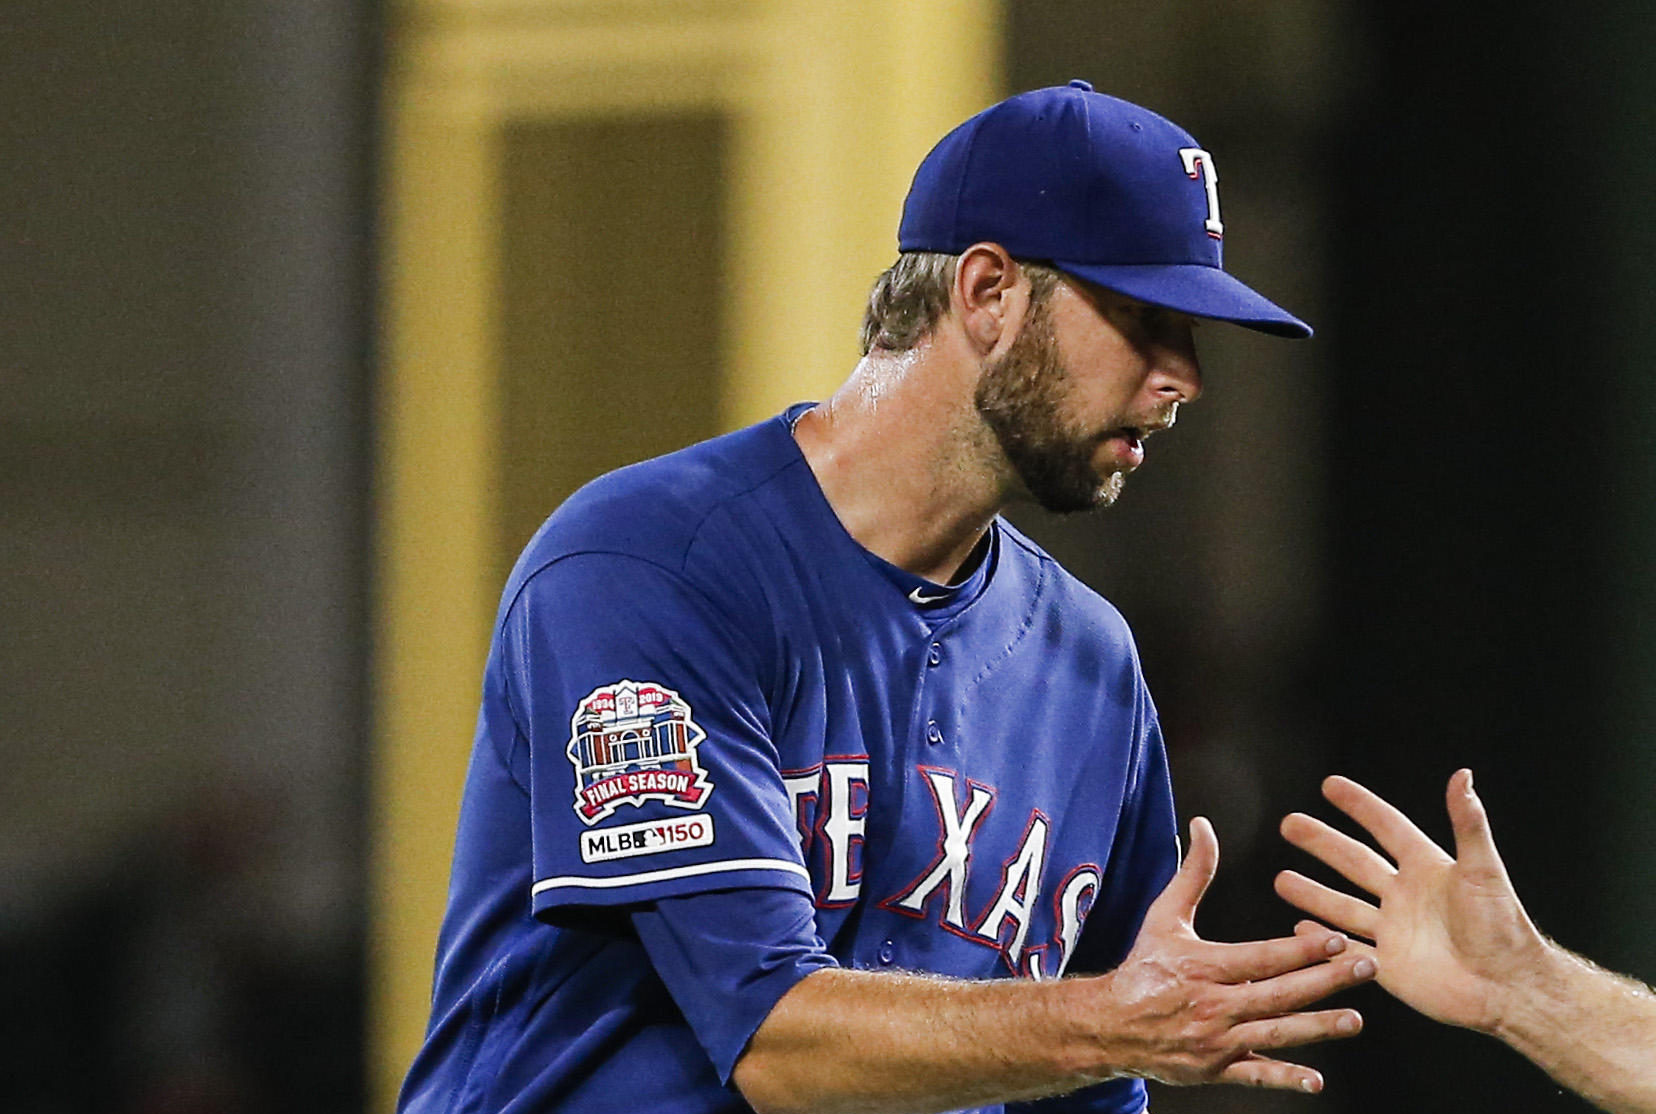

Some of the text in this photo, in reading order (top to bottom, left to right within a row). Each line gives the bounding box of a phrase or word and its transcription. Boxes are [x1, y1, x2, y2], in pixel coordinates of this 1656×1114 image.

[587, 773, 689, 806] FINAL SEASON
[588, 822, 704, 855] MLB 150
